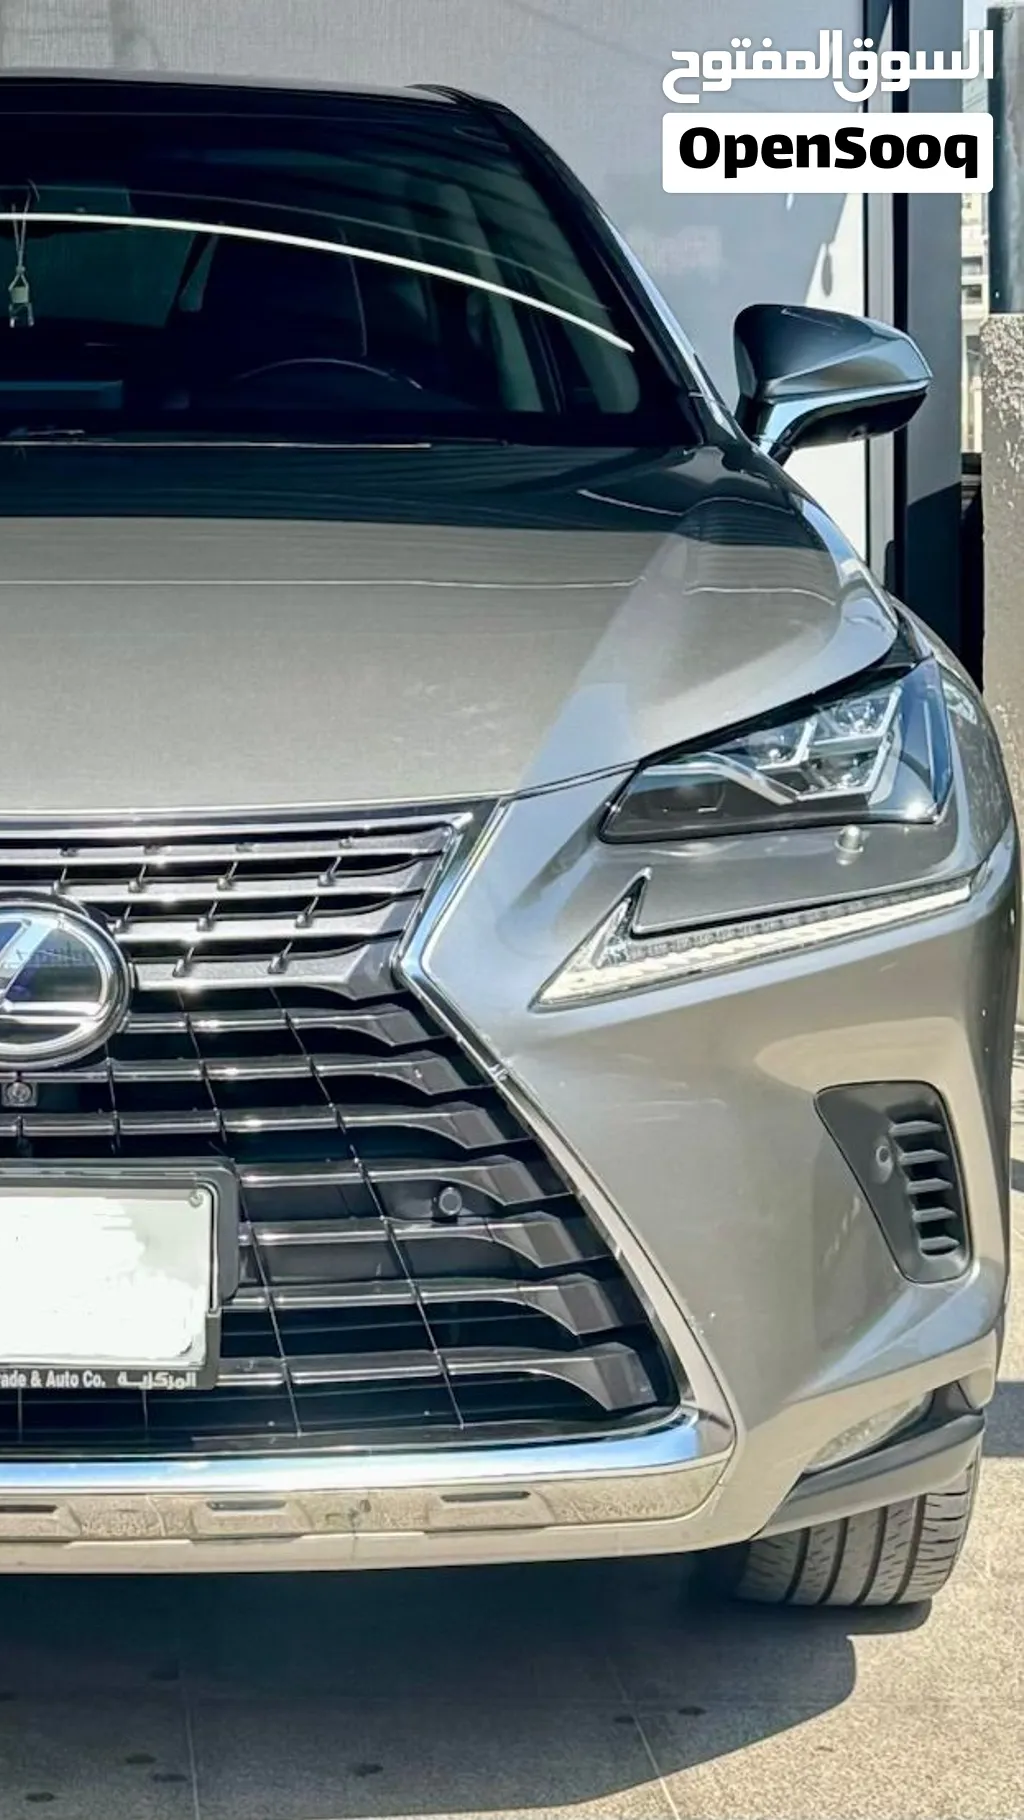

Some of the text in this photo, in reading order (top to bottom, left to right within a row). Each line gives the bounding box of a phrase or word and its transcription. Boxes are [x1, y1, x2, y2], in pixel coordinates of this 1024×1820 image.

[30, 1370, 43, 1388] &
[46, 1370, 79, 1388] Auto
[82, 1370, 106, 1388] Co.
